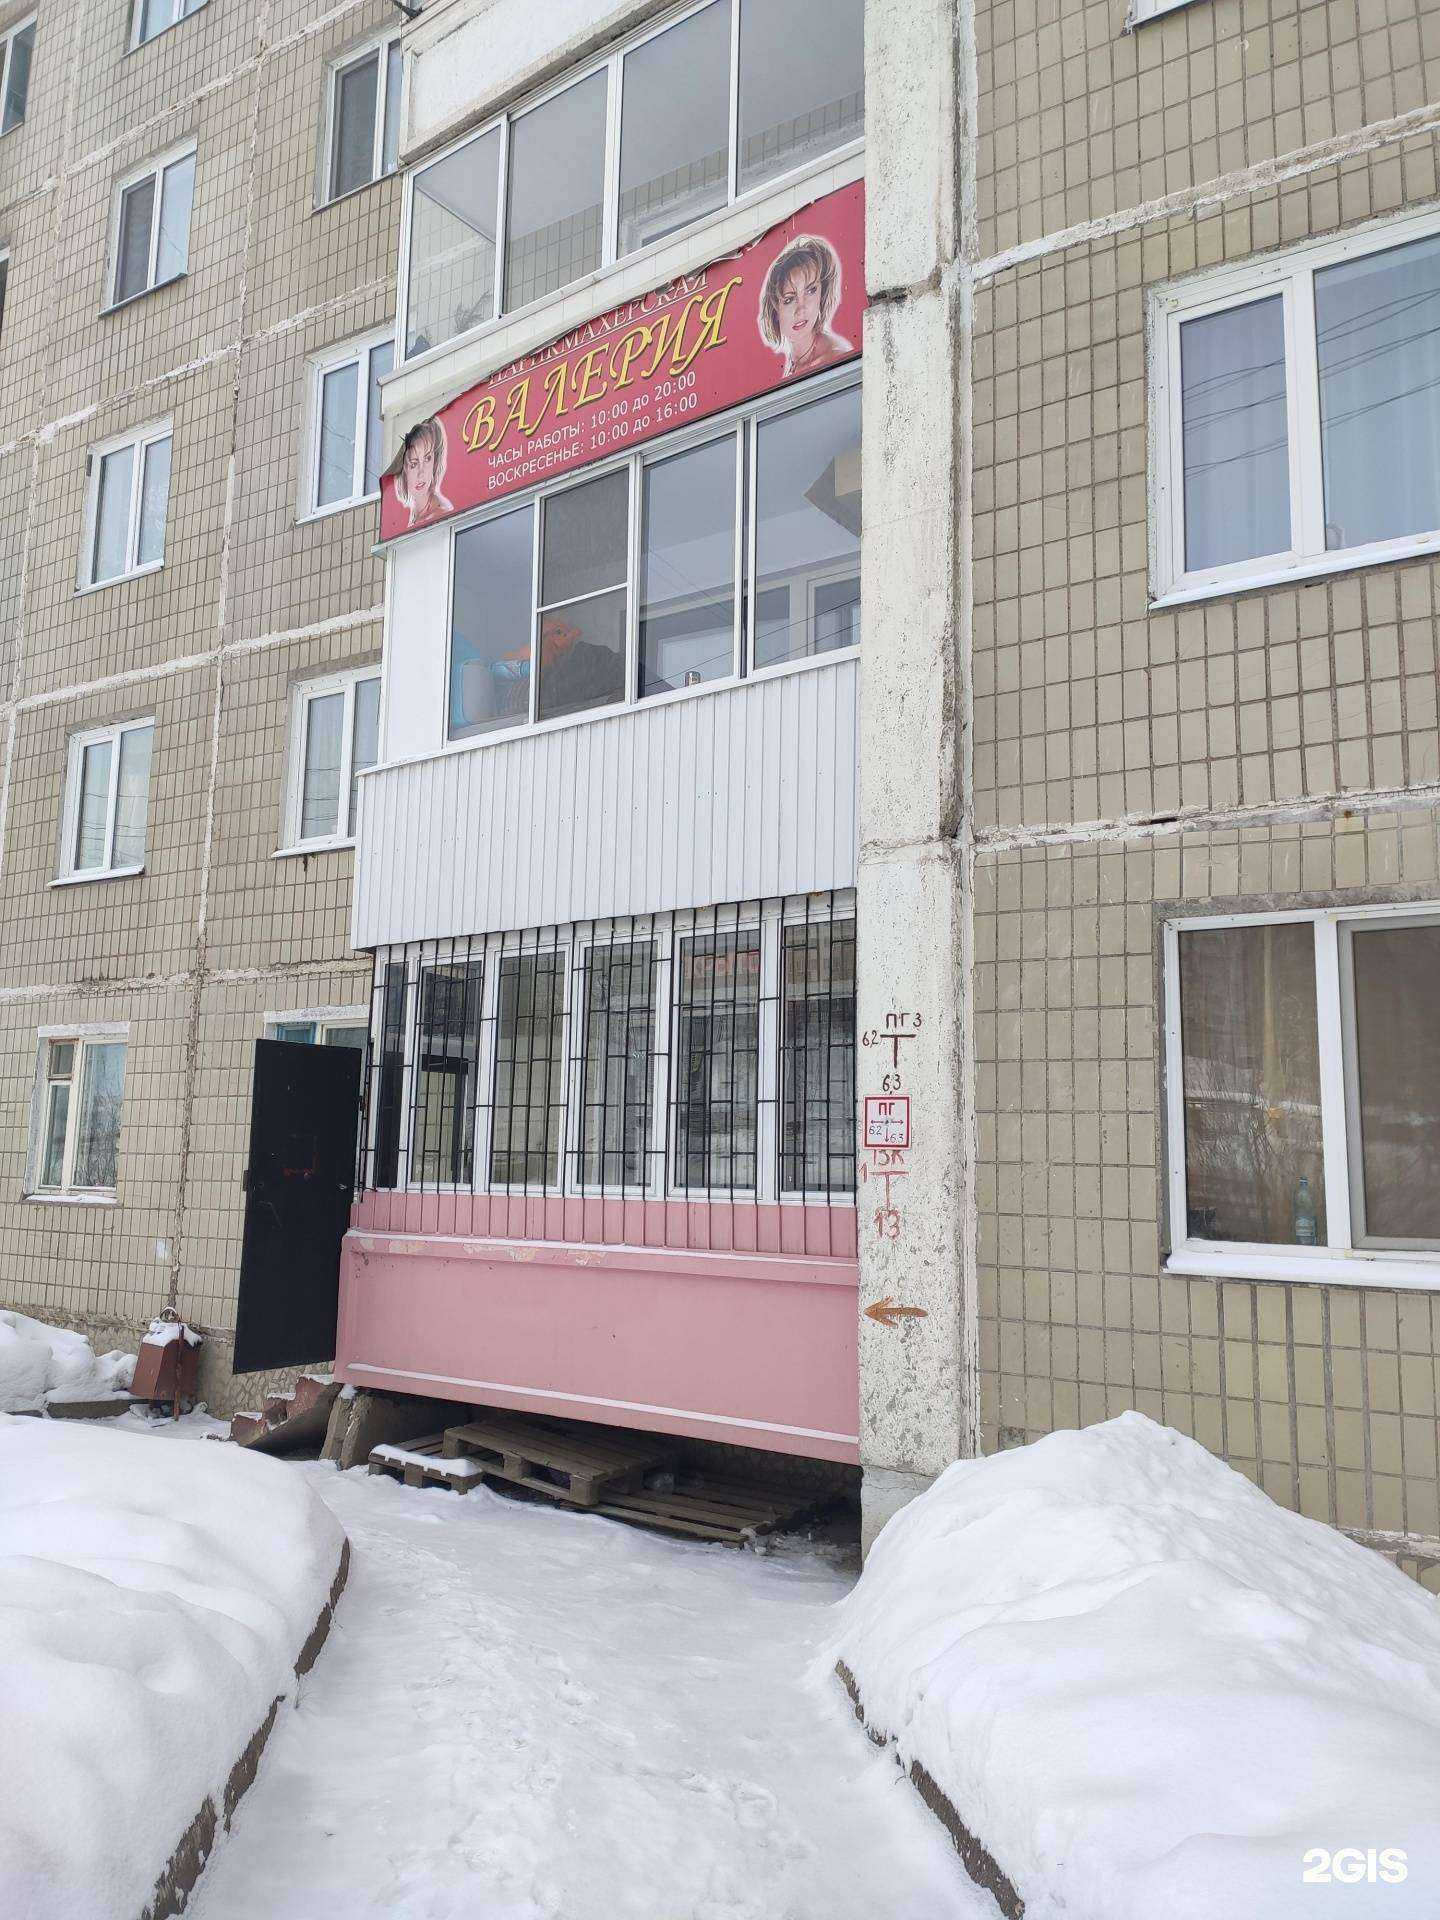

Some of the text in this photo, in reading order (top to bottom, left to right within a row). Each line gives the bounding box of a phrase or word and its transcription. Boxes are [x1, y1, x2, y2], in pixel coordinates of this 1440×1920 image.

[462, 277, 743, 453] ВАЛЕРИЯ
[488, 371, 696, 468] ЧАСЫ РАБОТЫ: 10:00 до 20:00
[488, 392, 698, 490] ВОСКРЕСЕНЬЕ: 10:00 до 16:00
